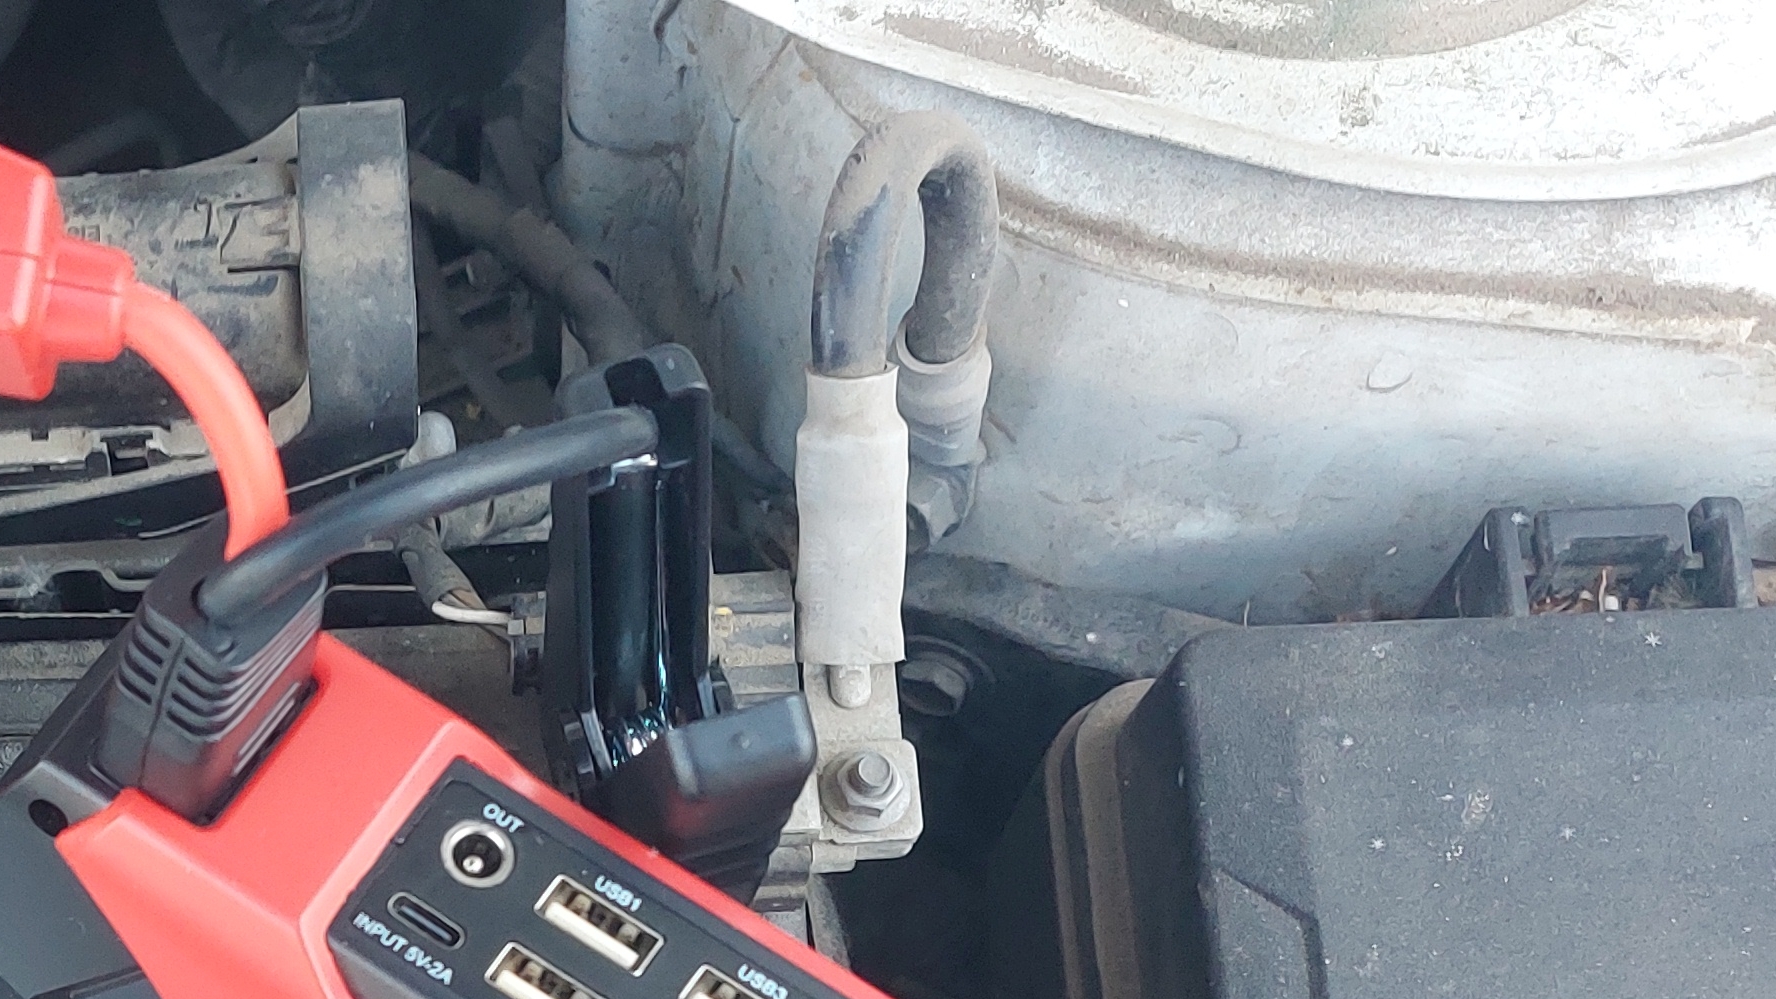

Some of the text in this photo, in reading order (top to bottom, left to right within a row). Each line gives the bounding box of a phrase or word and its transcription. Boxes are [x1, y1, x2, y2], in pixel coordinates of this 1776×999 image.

[483, 802, 524, 833] OUT
[594, 875, 643, 911] USB1
[353, 911, 408, 953] INPUT
